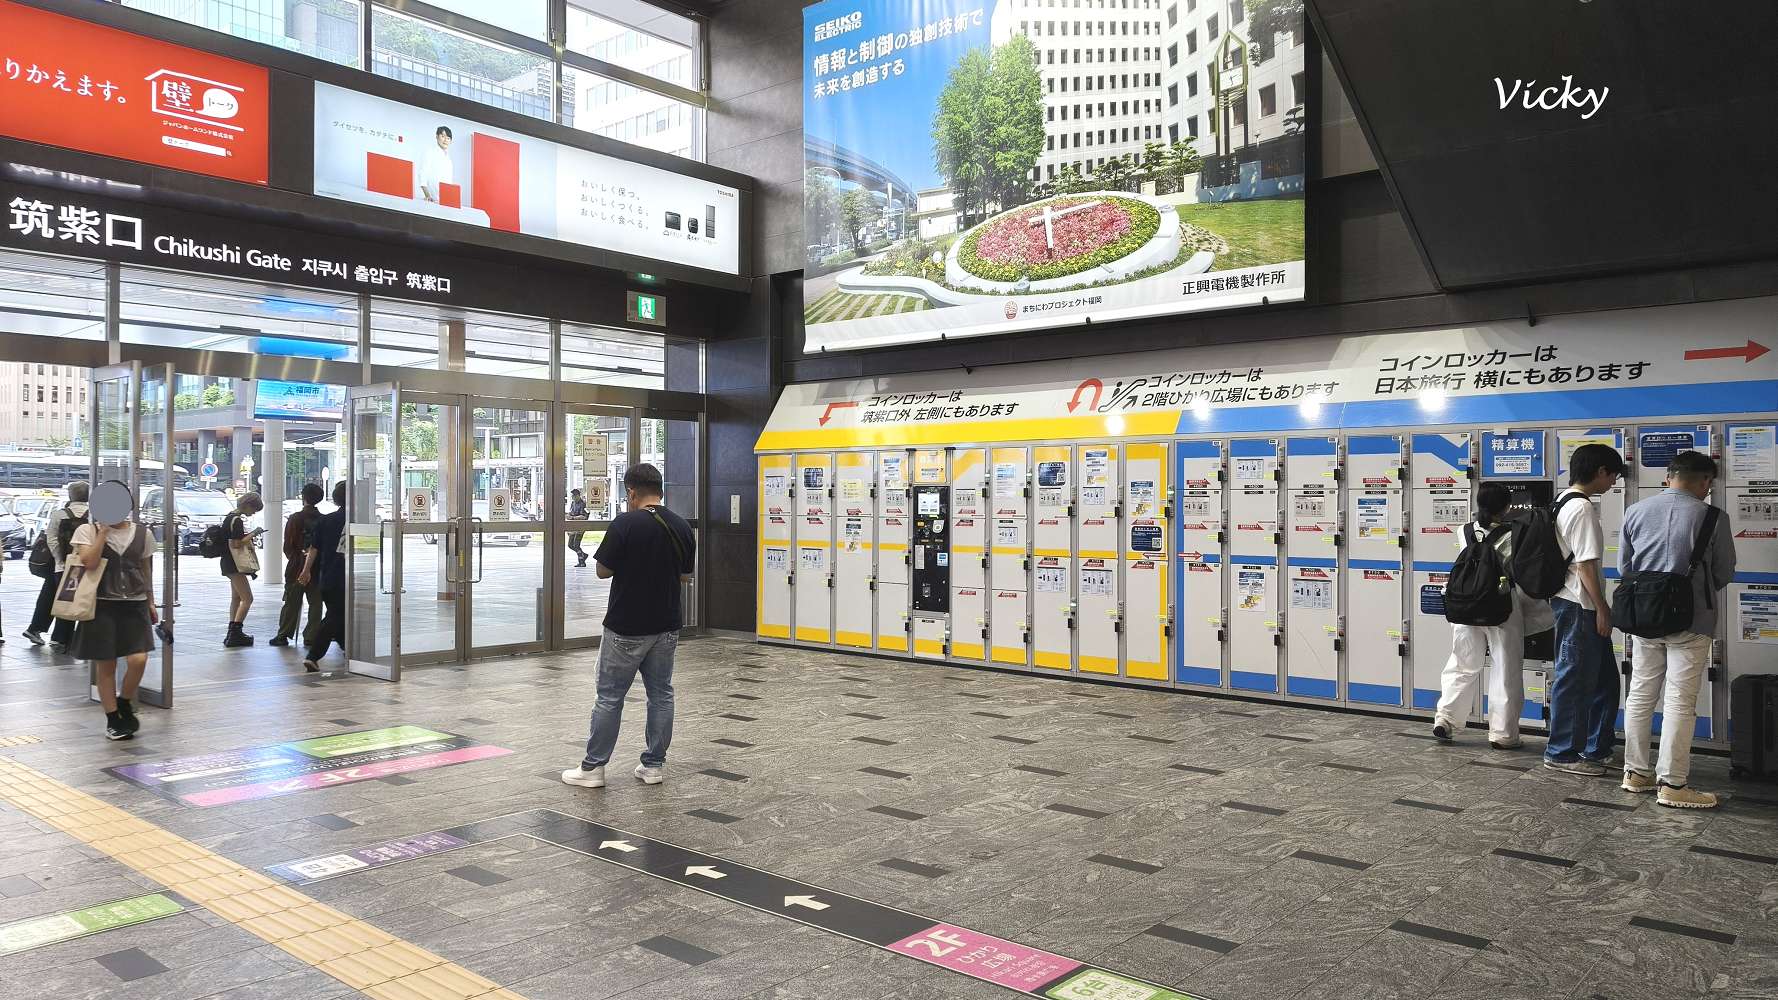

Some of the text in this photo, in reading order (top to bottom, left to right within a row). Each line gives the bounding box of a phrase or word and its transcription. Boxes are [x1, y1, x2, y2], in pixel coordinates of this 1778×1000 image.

[814, 11, 863, 33] SEIKO
[814, 21, 863, 42] ELECTRIC
[813, 8, 984, 77] 情報と制御の独創技術で
[0, 57, 127, 104] りかえます。
[813, 58, 905, 99] 未来を創造する
[161, 79, 195, 113] 壁
[9, 197, 143, 251] 筑紫口
[153, 235, 292, 271] Chikushi Gate
[301, 257, 398, 286] 지쿠시 출입구
[405, 270, 451, 294] 筑紫口
[1181, 269, 1287, 297] 正興電機製作所
[1022, 295, 1103, 314] まちにわプロジェクト福岡
[1378, 344, 1559, 373] コインロッカーは
[1148, 367, 1264, 388] コインロッカーは
[1374, 361, 1652, 395] 日本旅行 横にもあります
[868, 390, 963, 408] コインロッカーは
[1141, 381, 1340, 407] 2階ひかり広場にもあります
[861, 402, 1019, 423] 筑紫口外 左側にもあります
[1491, 438, 1535, 451] 精算機
[905, 929, 968, 958] 2F
